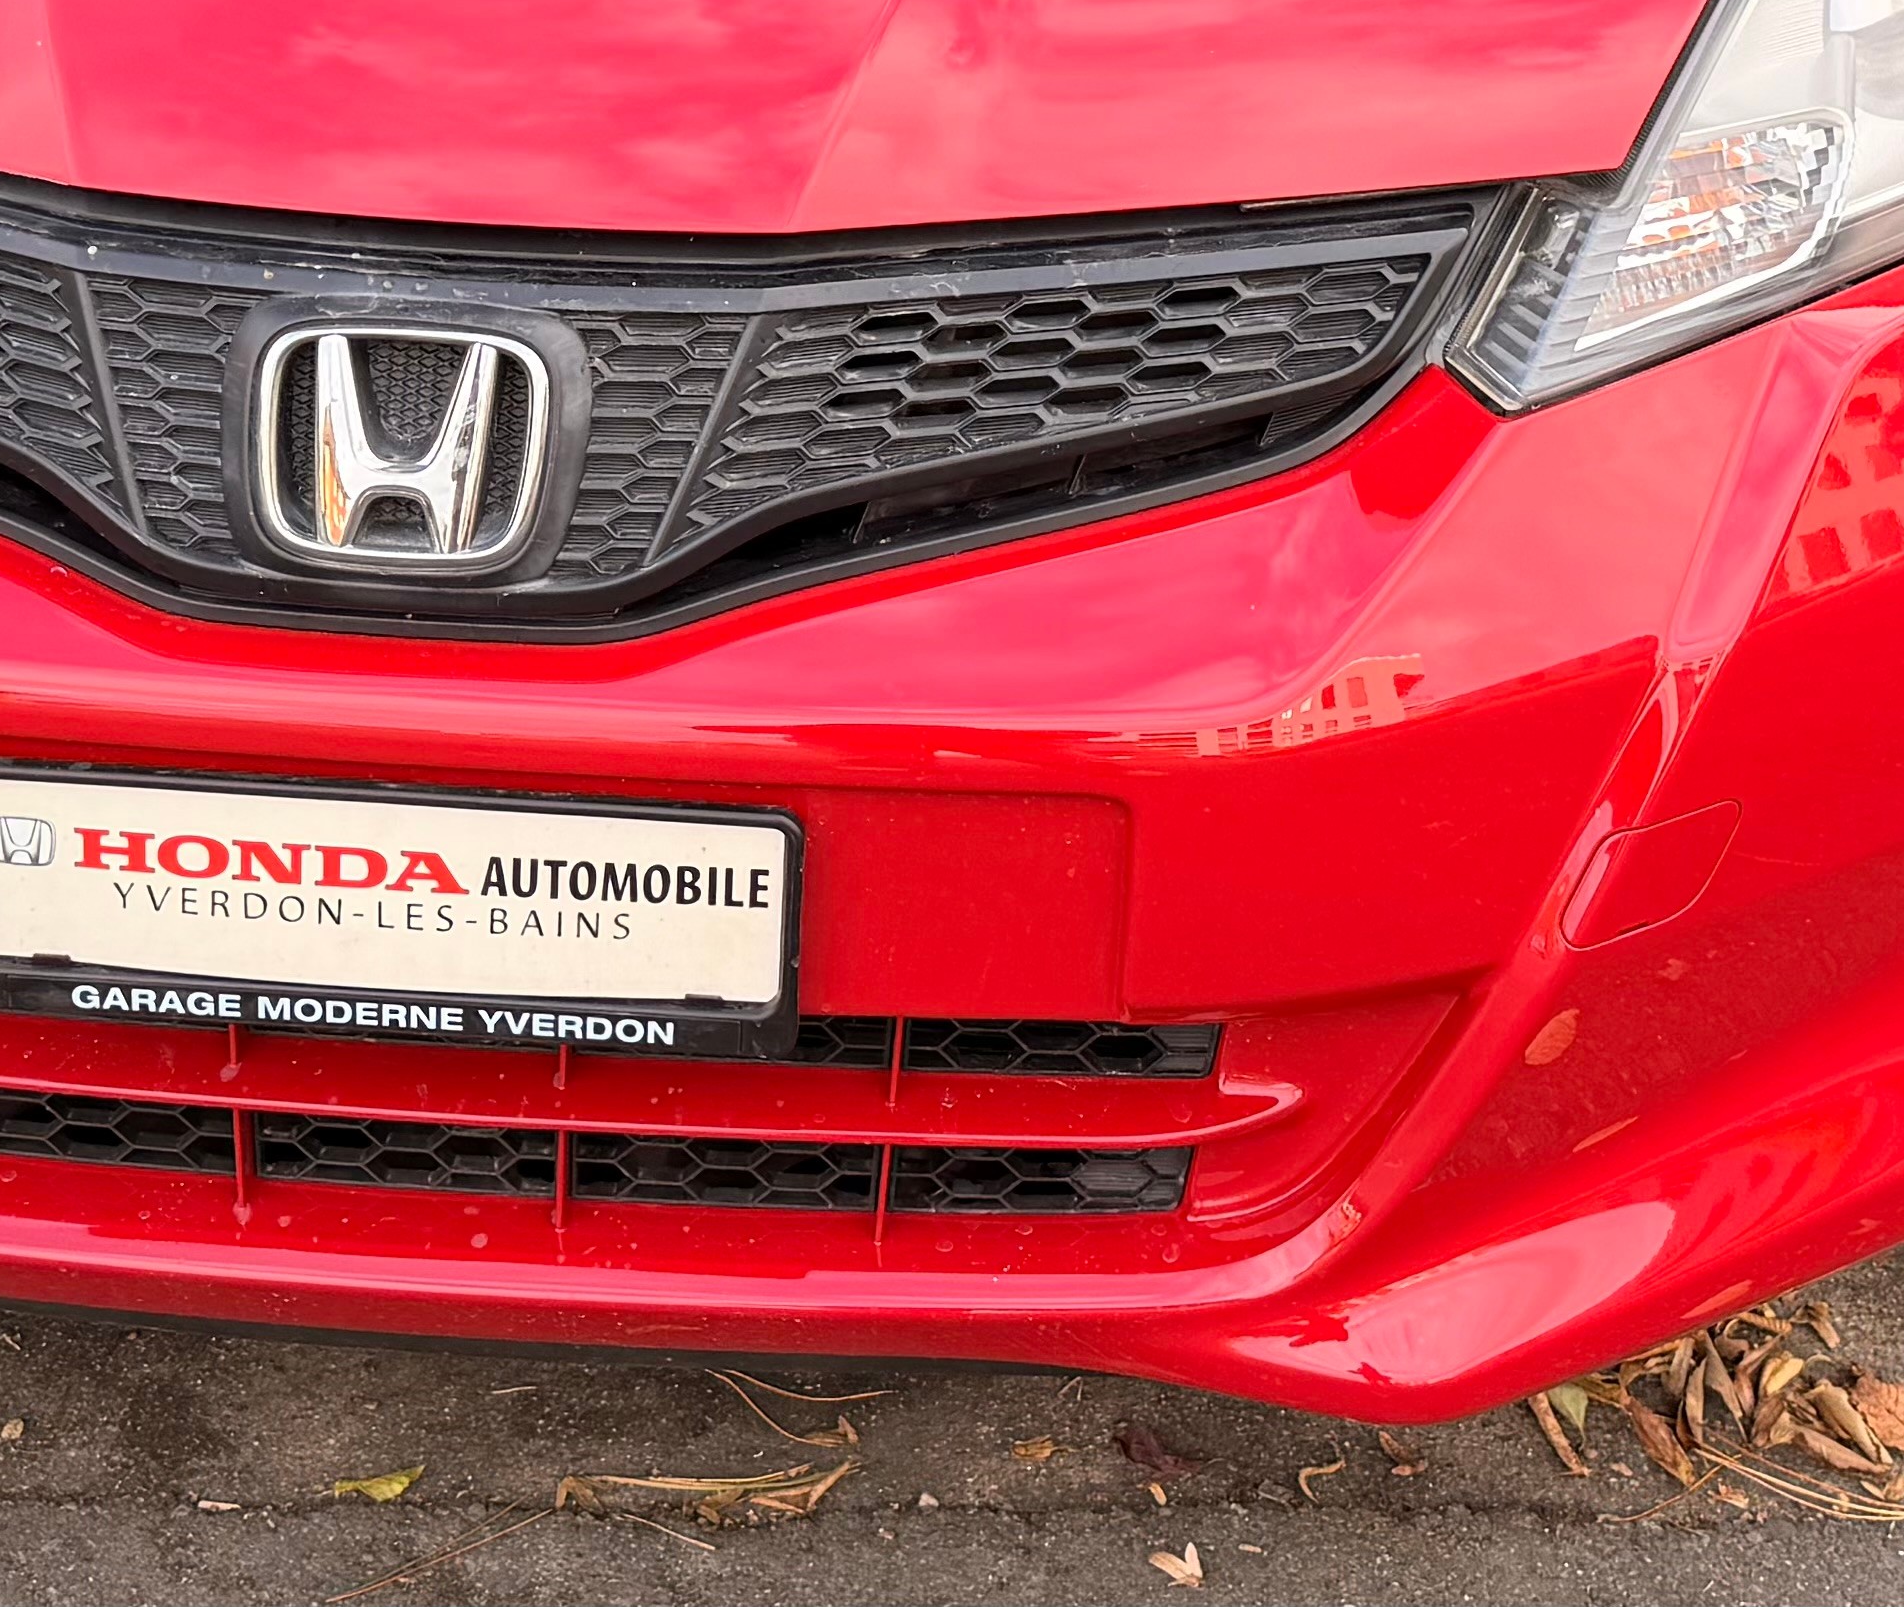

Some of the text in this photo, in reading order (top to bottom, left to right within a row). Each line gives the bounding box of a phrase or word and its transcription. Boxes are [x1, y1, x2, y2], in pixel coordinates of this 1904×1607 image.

[73, 826, 470, 895] HONDA
[480, 855, 770, 909] AUTOMOBILE
[112, 881, 632, 940] YVERDON-LES-BAINS
[70, 984, 676, 1046] GARAGE MODERNE YVERDON
